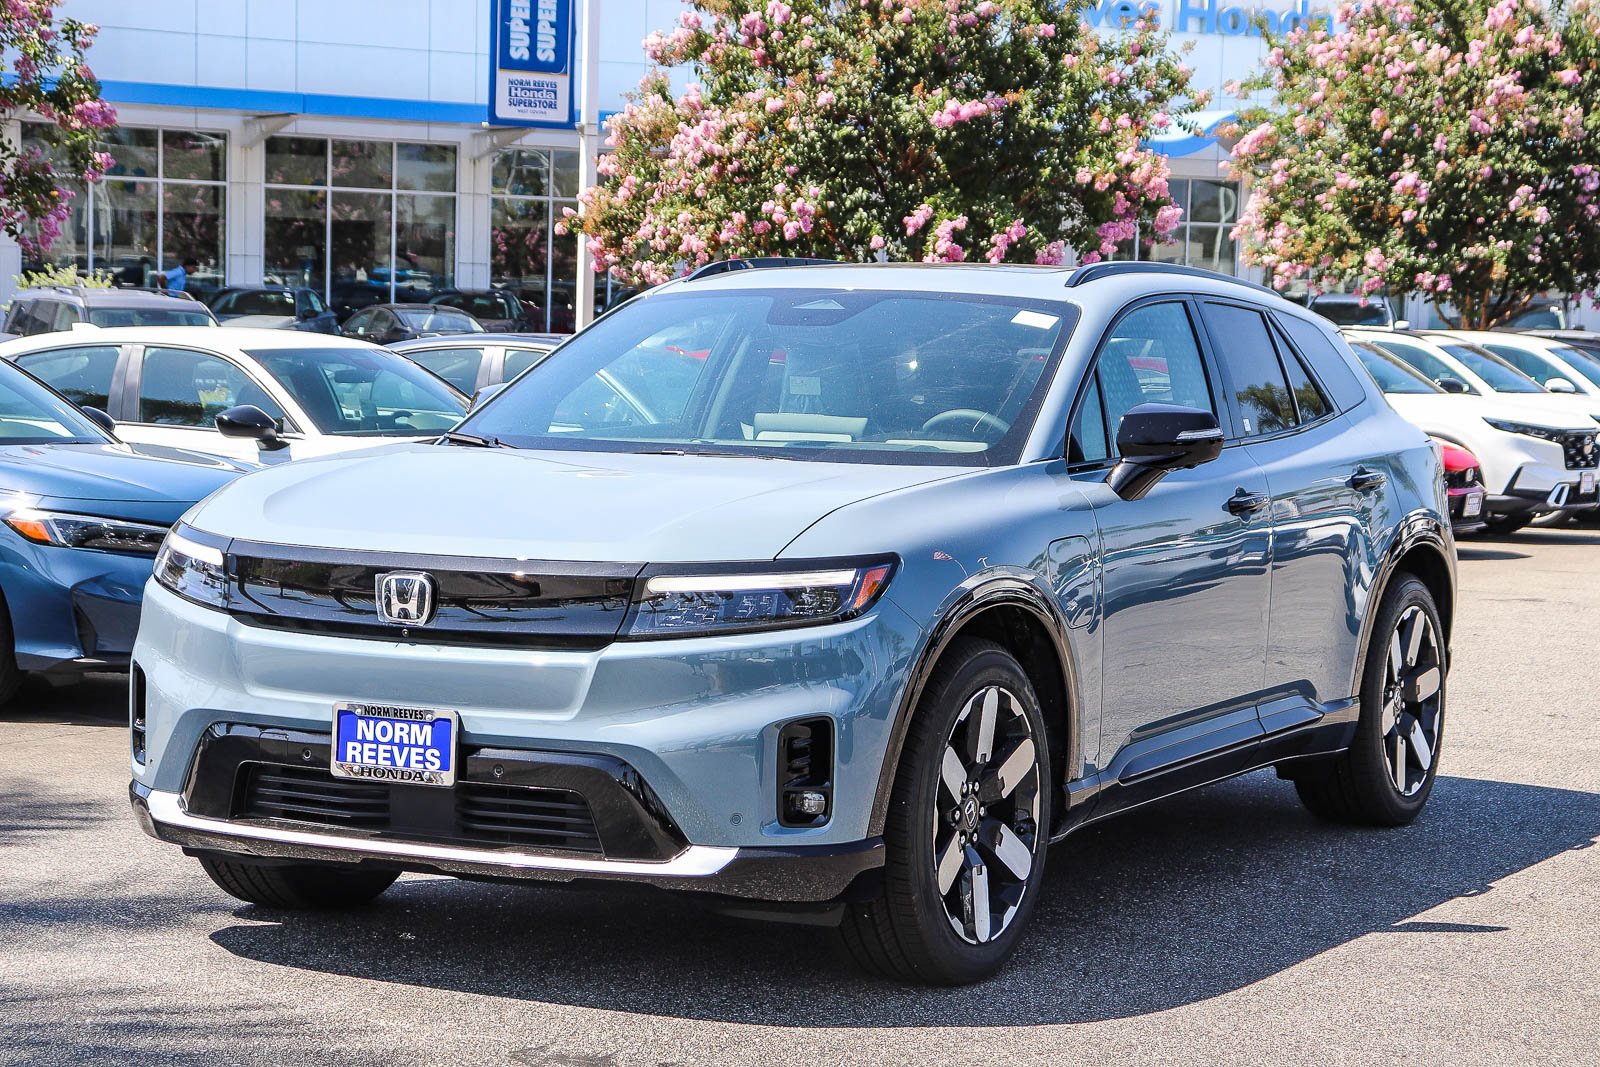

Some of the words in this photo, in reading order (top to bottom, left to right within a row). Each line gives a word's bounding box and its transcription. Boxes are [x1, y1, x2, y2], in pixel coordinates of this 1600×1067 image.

[508, 78, 531, 87] NORM
[533, 80, 557, 89] REEVES
[510, 87, 555, 99] Honda
[508, 98, 557, 109] SUPERSTORE
[364, 706, 391, 718] NORM
[393, 708, 424, 720] REEVES
[356, 719, 432, 746] NORM
[346, 741, 441, 771] REEVES
[360, 766, 425, 781] HONDA
